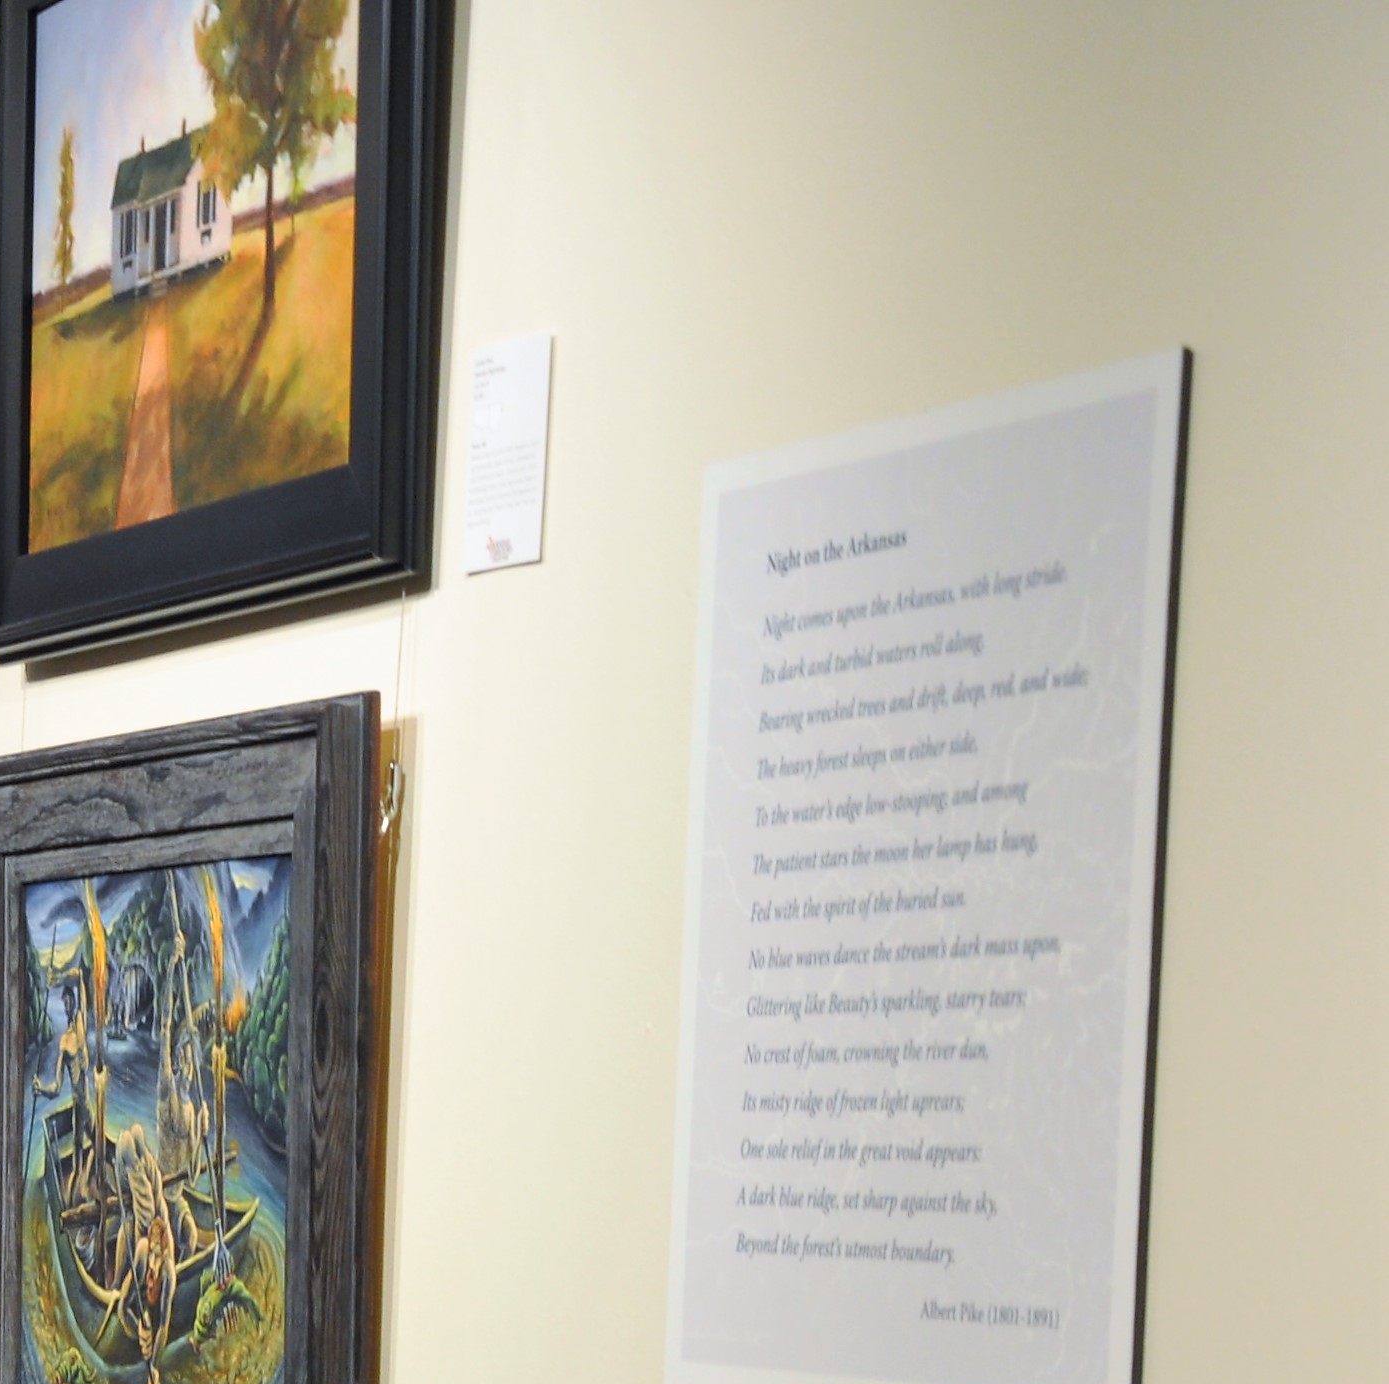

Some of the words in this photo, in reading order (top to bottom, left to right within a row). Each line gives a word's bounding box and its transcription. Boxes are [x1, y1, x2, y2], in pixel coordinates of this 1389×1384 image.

[768, 549, 801, 577] Night
[804, 550, 820, 566] on
[823, 540, 844, 562] the
[848, 532, 907, 557] Arkansas
[763, 612, 795, 641] Night
[797, 610, 833, 631] comes
[836, 604, 867, 629] upon
[870, 594, 890, 618] the
[960, 573, 990, 600] with
[761, 664, 775, 685] Its
[778, 657, 805, 682] dark
[807, 652, 833, 677] and
[834, 644, 874, 673] turbid
[876, 645, 917, 664] waters
[920, 632, 944, 657] roll
[759, 710, 804, 734] Bearing
[807, 697, 855, 724] wrecked
[857, 699, 886, 718] trees
[889, 688, 915, 714] and
[1019, 666, 1049, 695] and
[758, 758, 777, 780] The
[779, 755, 813, 780] heavy
[812, 750, 849, 779] forest
[852, 744, 886, 772] sleeps
[890, 746, 906, 762] on
[908, 736, 946, 761] either
[756, 806, 768, 828] To
[771, 803, 790, 826] the
[835, 795, 863, 824] edge
[951, 780, 979, 806] and
[754, 853, 772, 875] The
[774, 851, 817, 880] patient
[820, 850, 848, 869] stars
[851, 843, 871, 866] the
[874, 846, 909, 863] moon
[912, 837, 934, 860] her
[936, 834, 972, 862] lamp
[974, 832, 997, 854] has
[751, 900, 772, 923] Fed
[774, 897, 800, 920] with
[803, 896, 821, 919] the
[858, 891, 874, 921] of
[873, 891, 893, 914] the
[895, 886, 939, 912] buried
[749, 949, 765, 970] No
[768, 947, 793, 968] blue
[797, 952, 830, 966] waves
[833, 943, 870, 965] dance
[873, 940, 892, 963] the
[950, 934, 981, 959] dark
[747, 995, 802, 1022] Glittering
[804, 992, 826, 1015] like
[745, 1044, 761, 1064] No
[764, 1046, 790, 1064] crest
[793, 1041, 808, 1070] of
[843, 1042, 900, 1068] crowning
[903, 1038, 923, 1061] the
[926, 1041, 957, 1061] river
[743, 1091, 756, 1112] Its
[759, 1092, 791, 1117] misty
[794, 1089, 823, 1118] ridge
[825, 1089, 841, 1118] of
[880, 1089, 909, 1119] light
[740, 1138, 764, 1159] One
[766, 1138, 789, 1160] sole
[791, 1138, 824, 1166] relief
[823, 1141, 835, 1159] in
[839, 1138, 858, 1160] the
[859, 1144, 892, 1167] great
[896, 1138, 924, 1162] void
[737, 1186, 745, 1205] A
[749, 1185, 776, 1206] dark
[779, 1186, 804, 1208] blue
[843, 1192, 860, 1210] set
[863, 1188, 898, 1217] sharp
[900, 1192, 947, 1218] against
[951, 1190, 971, 1214] the
[736, 1232, 779, 1258] Beyond
[781, 1233, 800, 1256] the
[845, 1242, 888, 1260] utmost
[921, 1300, 956, 1321] Albert
[960, 1302, 984, 1323] Pike
